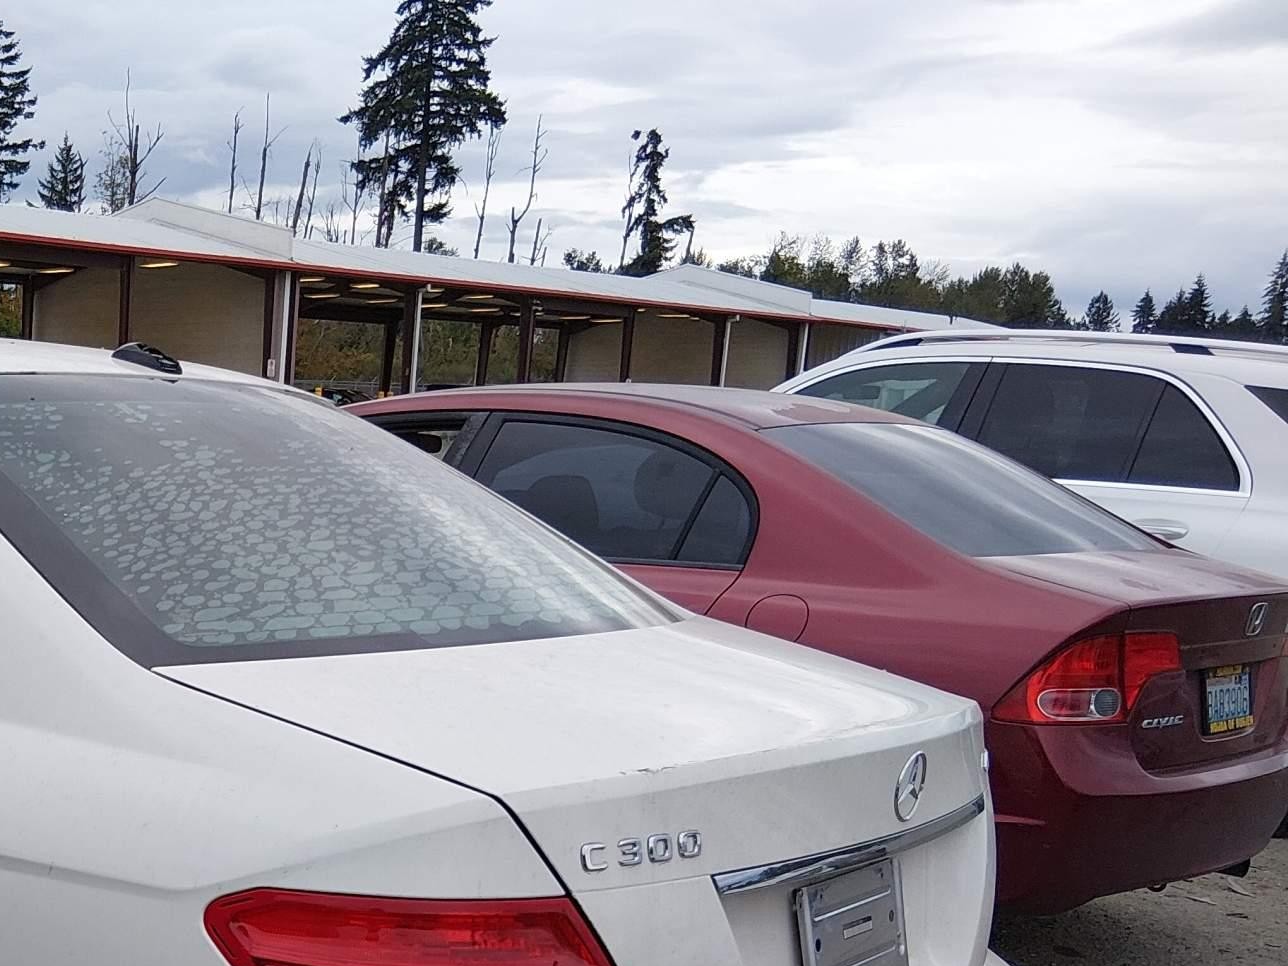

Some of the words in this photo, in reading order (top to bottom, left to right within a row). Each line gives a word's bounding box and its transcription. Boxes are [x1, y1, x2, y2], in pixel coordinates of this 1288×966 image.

[1142, 715, 1184, 728] CIVIC
[580, 842, 608, 872] C
[617, 830, 702, 867] 300
